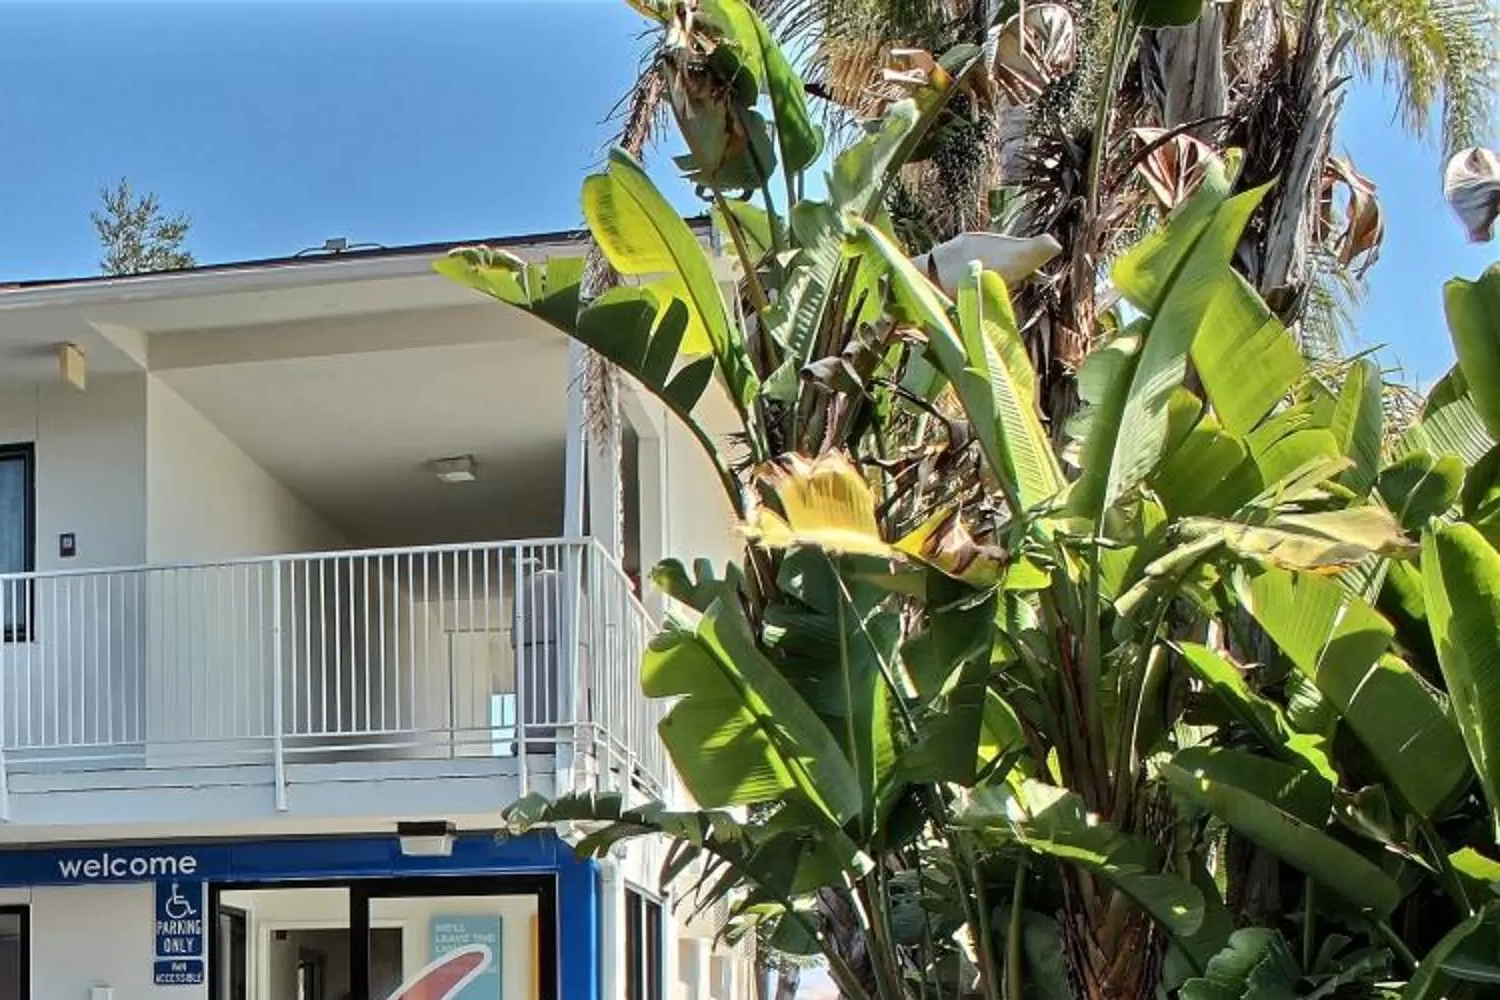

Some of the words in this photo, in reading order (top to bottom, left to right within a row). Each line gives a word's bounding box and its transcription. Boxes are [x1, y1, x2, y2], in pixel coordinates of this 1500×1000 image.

[58, 853, 197, 878] welcome
[156, 919, 201, 935] PARKING
[164, 937, 195, 952] ONLY
